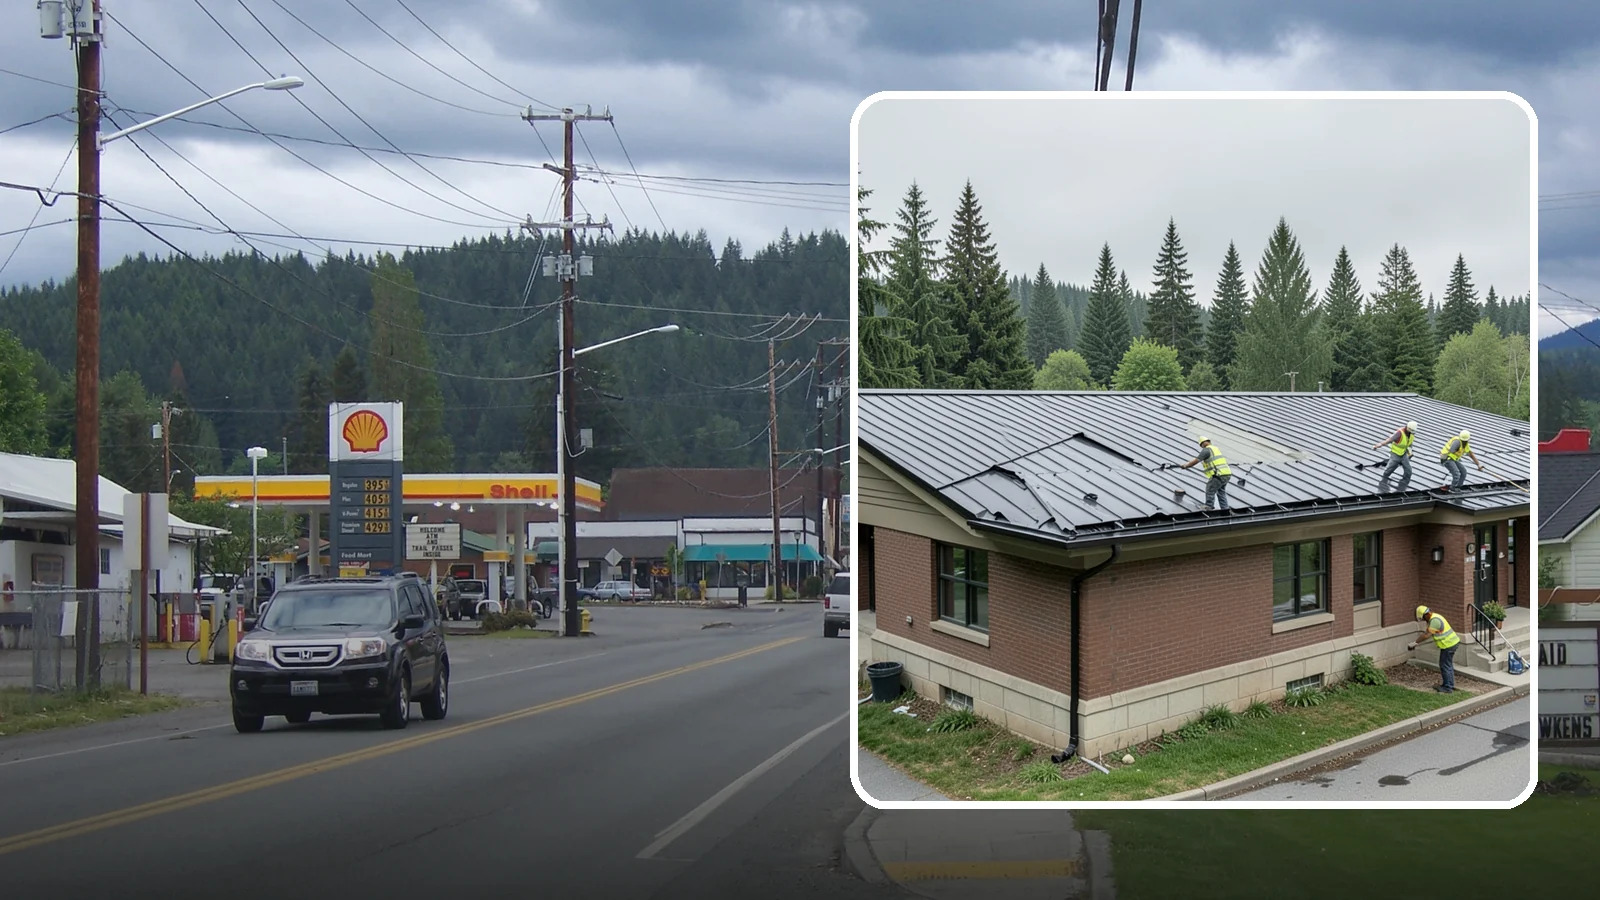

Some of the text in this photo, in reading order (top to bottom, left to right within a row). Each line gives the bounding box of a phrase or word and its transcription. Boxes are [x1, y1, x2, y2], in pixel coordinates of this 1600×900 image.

[365, 480, 383, 490] 395
[490, 484, 547, 499] Shell
[365, 494, 383, 504] 405
[365, 508, 383, 518] 415
[366, 522, 384, 532] 429
